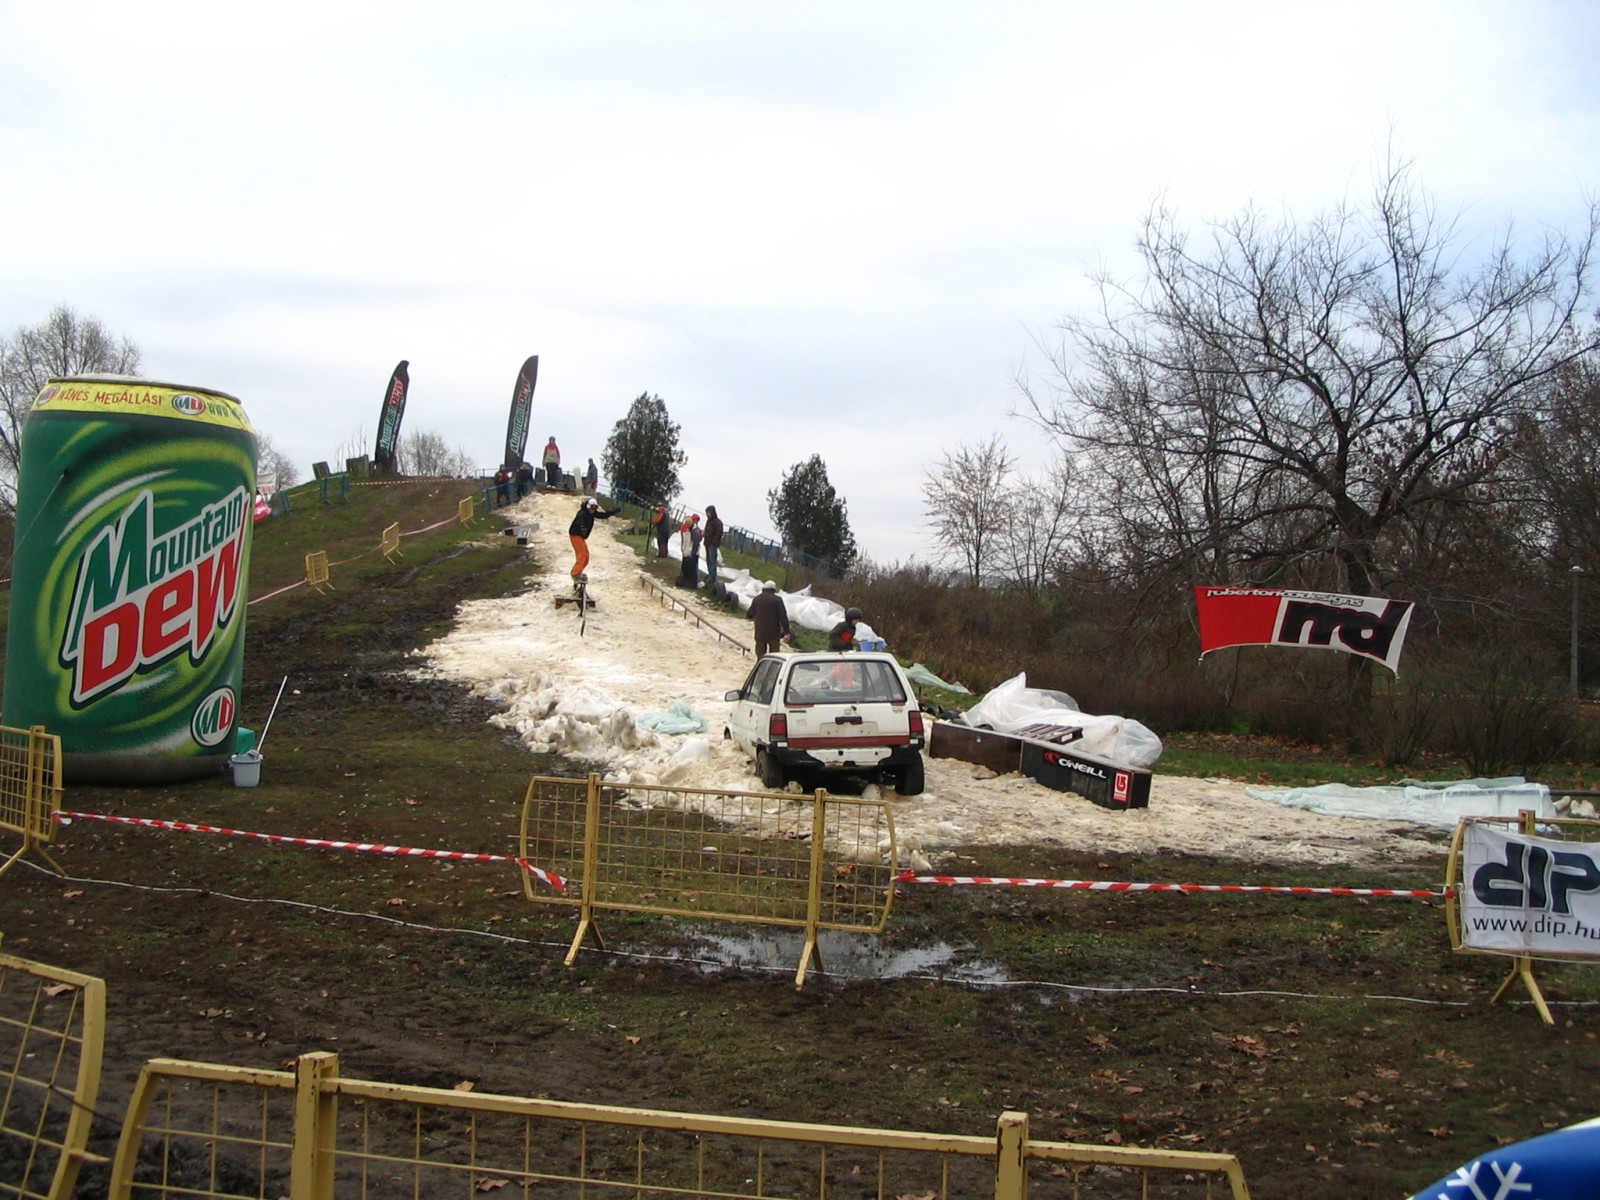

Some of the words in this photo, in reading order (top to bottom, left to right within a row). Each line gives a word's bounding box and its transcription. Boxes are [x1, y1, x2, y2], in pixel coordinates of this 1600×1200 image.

[57, 389, 89, 402] NINCS
[94, 390, 162, 406] MEGÁLLÁSI
[509, 405, 526, 457] Mountain
[66, 490, 244, 654] Mountain
[201, 695, 235, 735] MD
